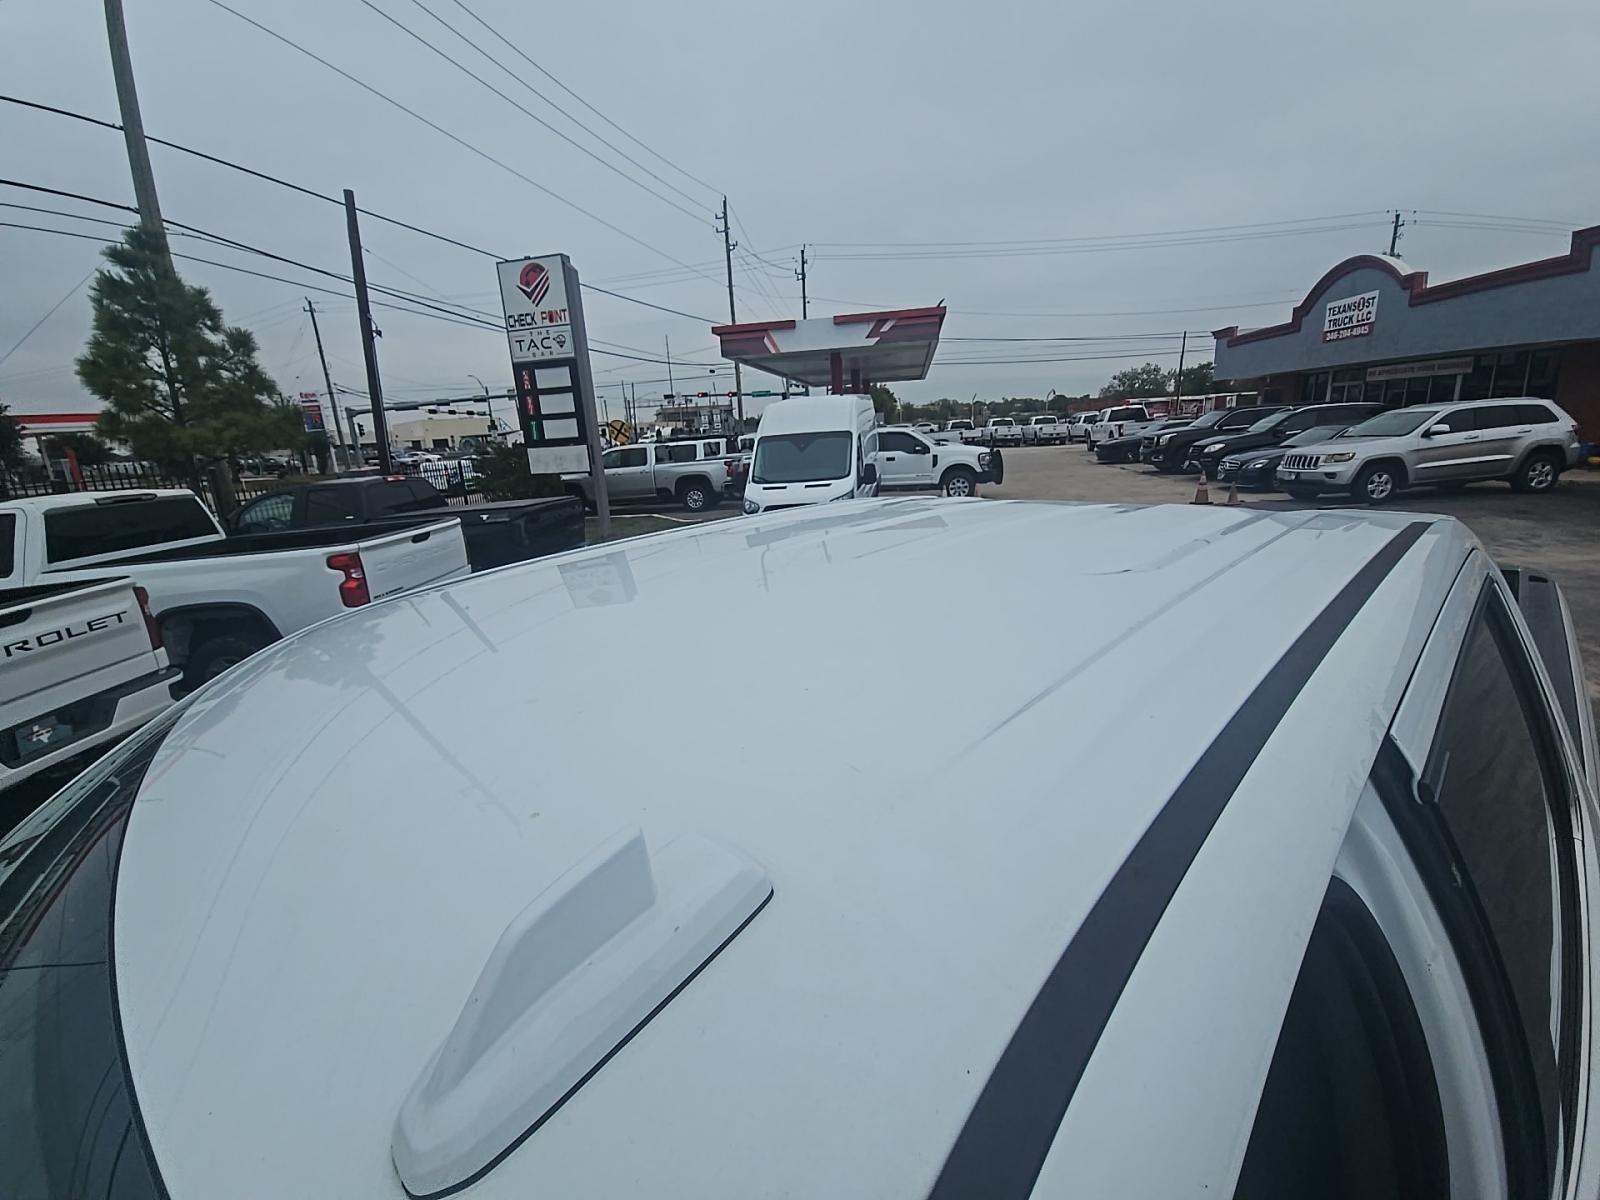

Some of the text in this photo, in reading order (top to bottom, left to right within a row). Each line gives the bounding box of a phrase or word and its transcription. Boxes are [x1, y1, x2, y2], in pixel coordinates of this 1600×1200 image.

[507, 308, 567, 328] CHECK POINT
[1328, 310, 1372, 329] TRUCK LLC
